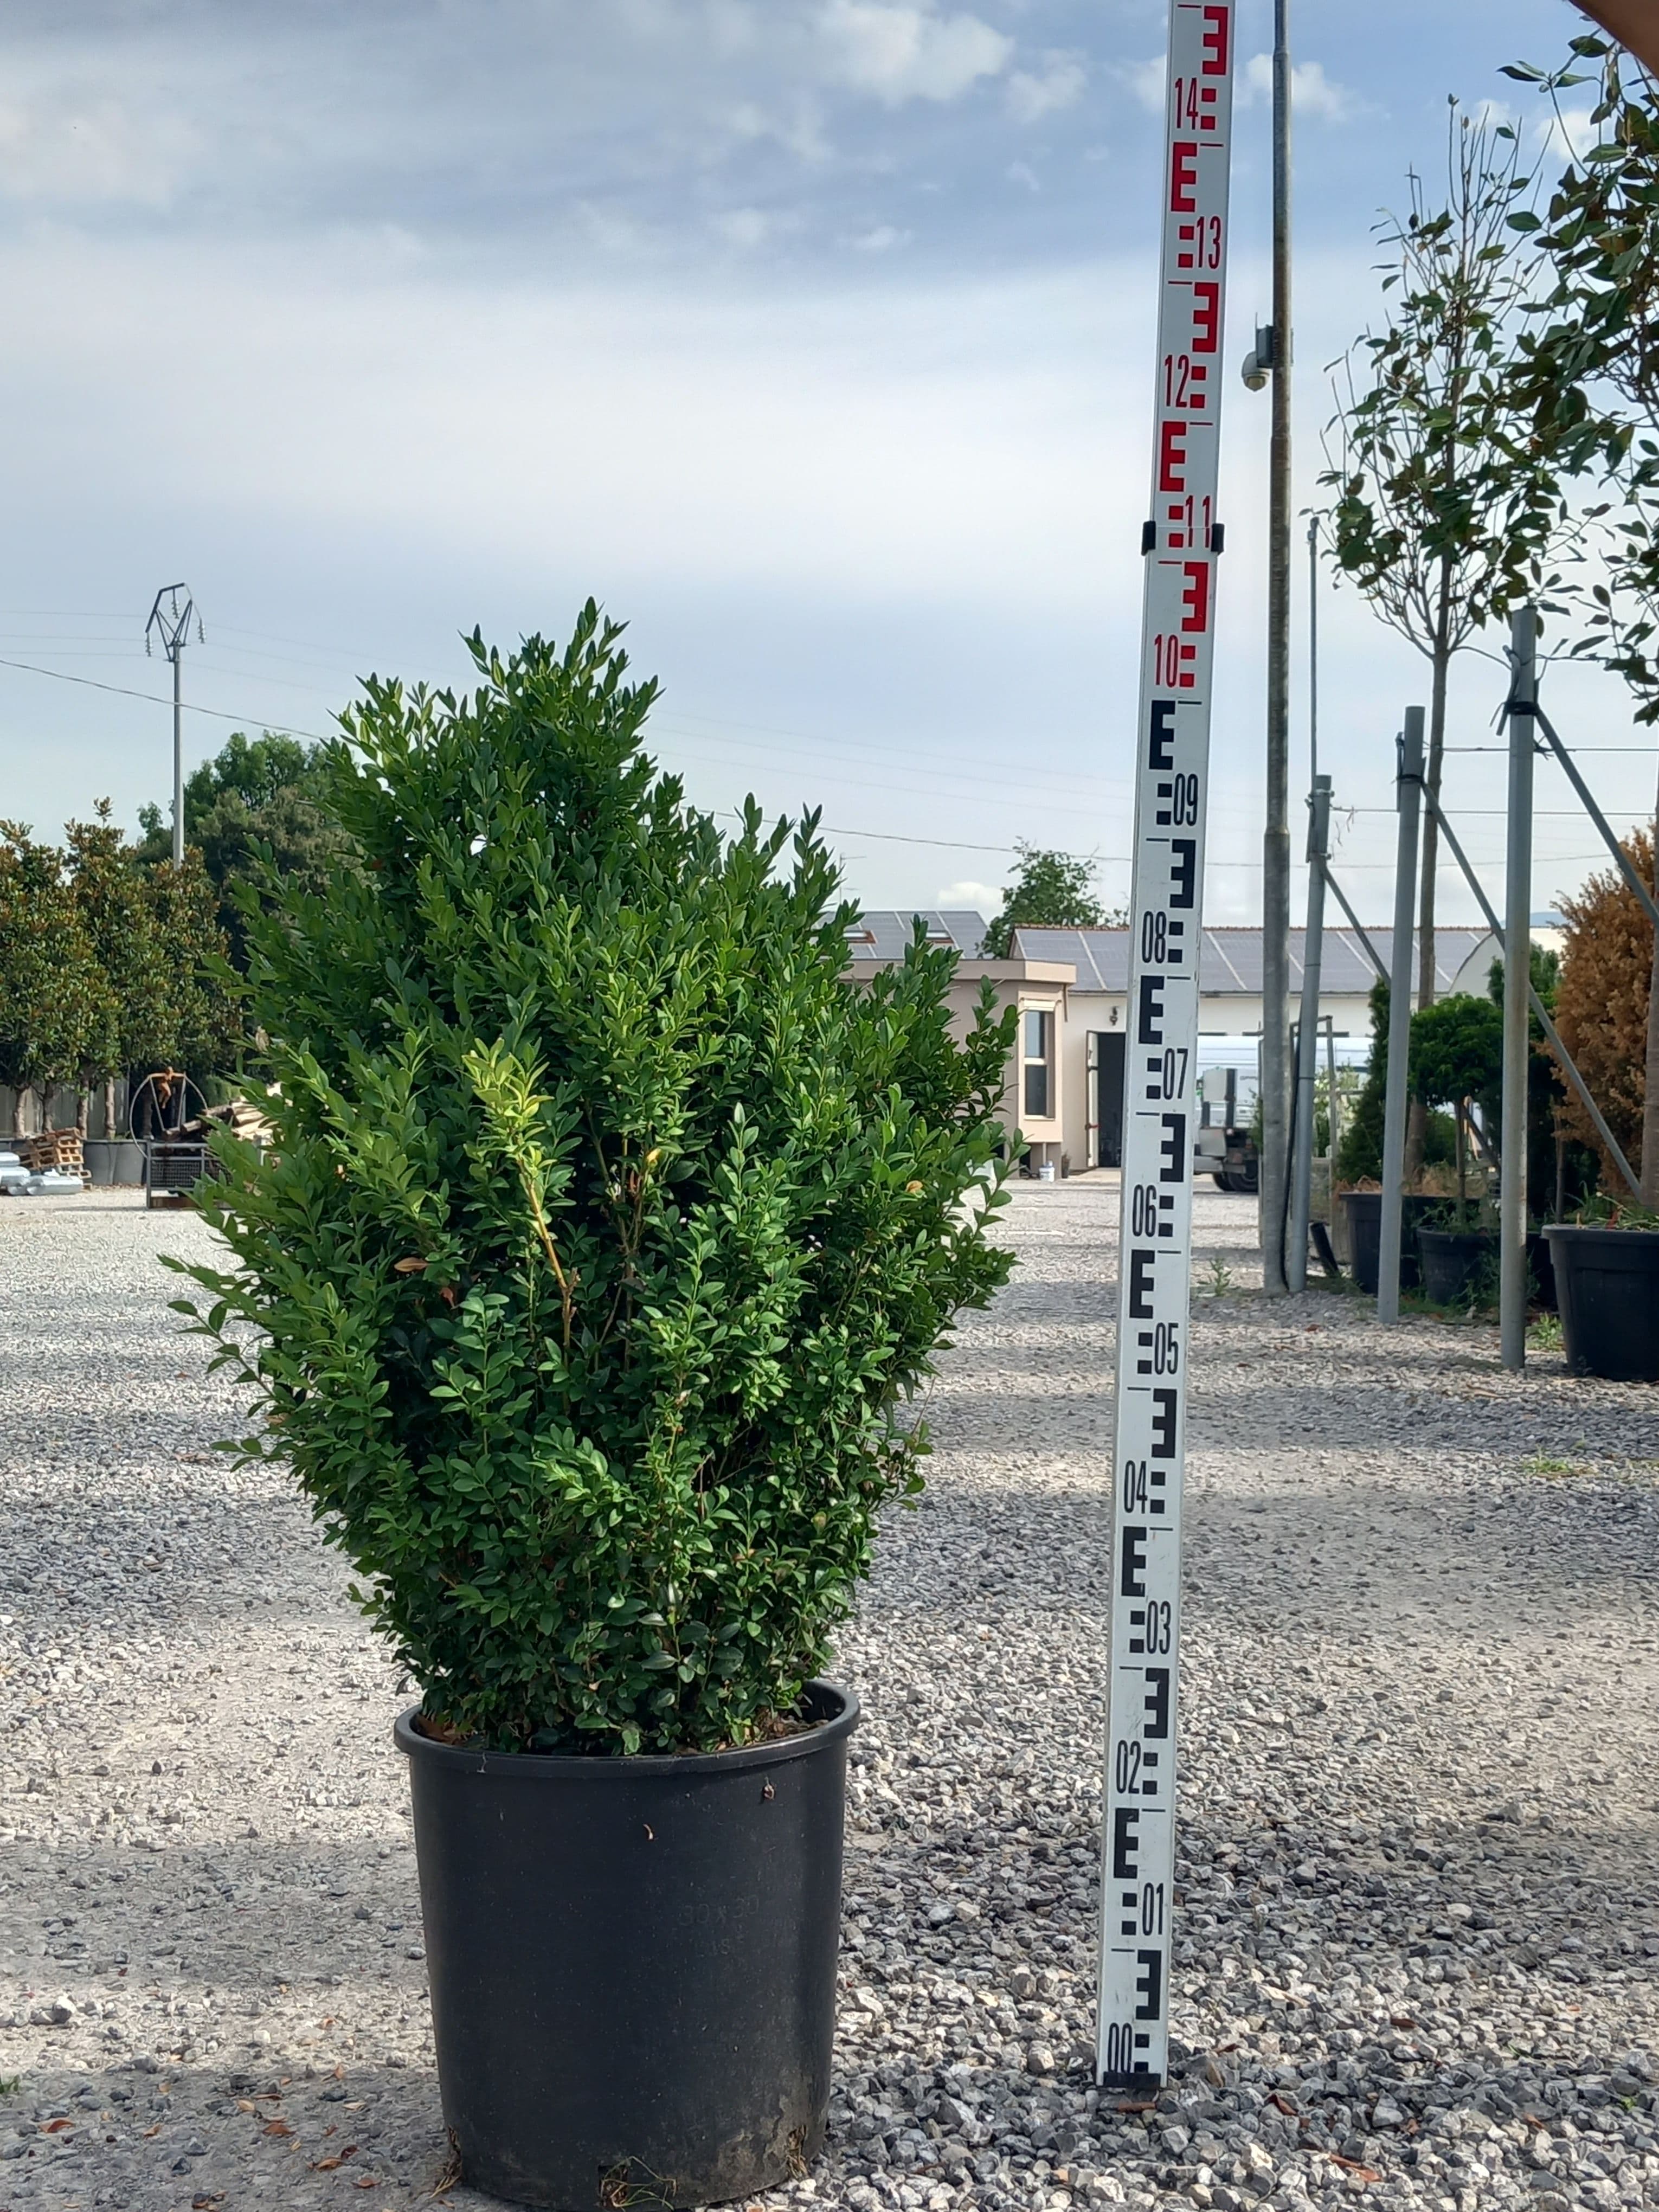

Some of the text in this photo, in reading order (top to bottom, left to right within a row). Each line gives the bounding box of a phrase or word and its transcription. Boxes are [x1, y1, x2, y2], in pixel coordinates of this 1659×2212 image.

[1174, 78, 1198, 129] 14
[1196, 216, 1221, 269] 13
[1165, 355, 1189, 407] 12
[1185, 495, 1210, 548] 11
[1154, 634, 1178, 687] 10
[1173, 773, 1198, 826] 09
[1141, 911, 1166, 963] 08
[1163, 1048, 1188, 1099] 07
[1132, 1184, 1156, 1237] 06
[1154, 1322, 1179, 1374] 05
[1124, 1461, 1147, 1513] 04
[1146, 1600, 1171, 1654] 03
[1116, 1740, 1140, 1793] 02
[1142, 1882, 1163, 1935] 01
[1107, 2022, 1132, 2072] 00
